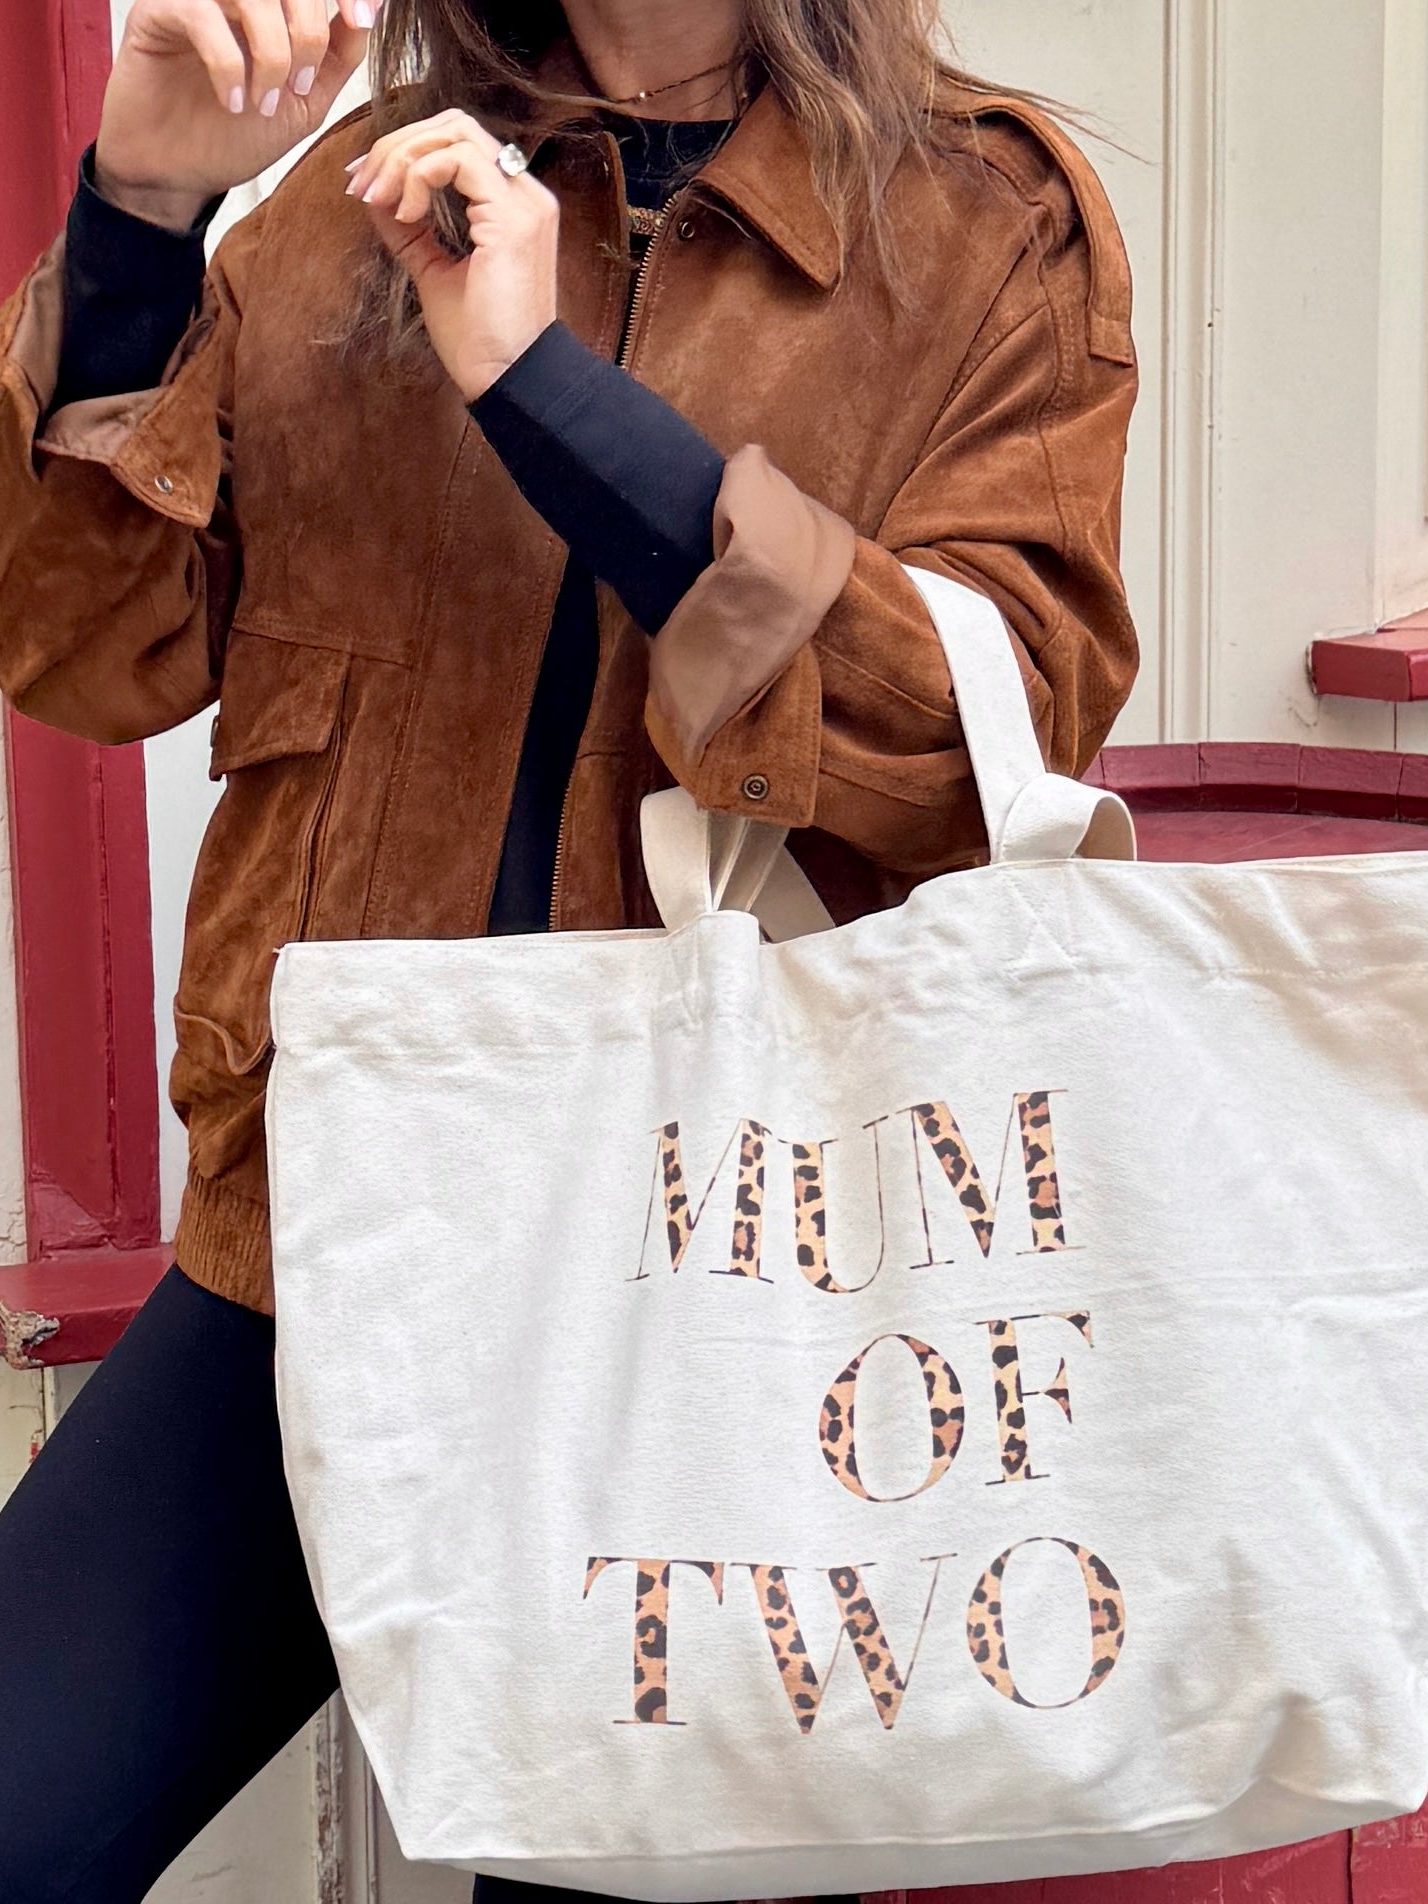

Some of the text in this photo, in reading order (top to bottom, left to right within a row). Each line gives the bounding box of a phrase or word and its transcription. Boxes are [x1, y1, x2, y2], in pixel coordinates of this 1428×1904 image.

[625, 1089, 1086, 1294] MUM
[818, 1310, 1094, 1503] OF
[583, 1536, 1125, 1735] TWO
